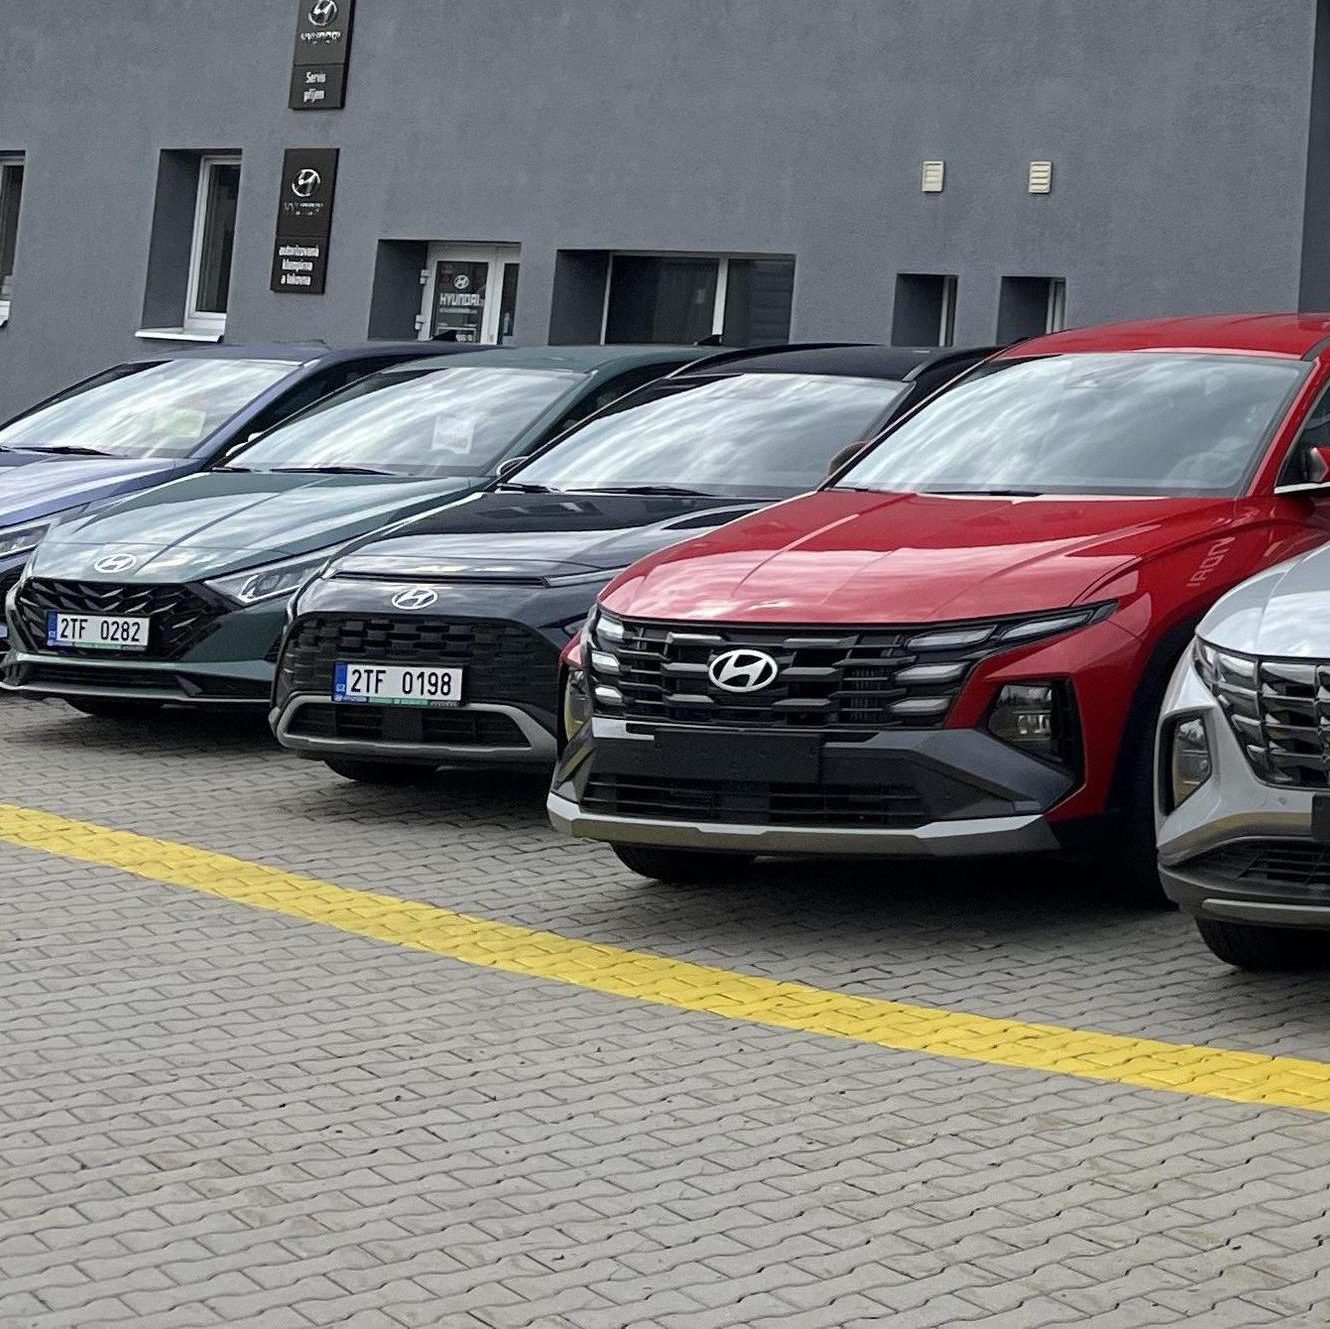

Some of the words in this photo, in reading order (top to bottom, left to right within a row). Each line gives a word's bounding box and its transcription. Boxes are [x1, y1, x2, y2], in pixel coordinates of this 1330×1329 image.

[440, 292, 482, 307] HYUNDAI
[60, 617, 89, 640] 2TF
[100, 619, 141, 643] 0282
[350, 669, 387, 694] 2TF
[401, 671, 452, 696] 0198
